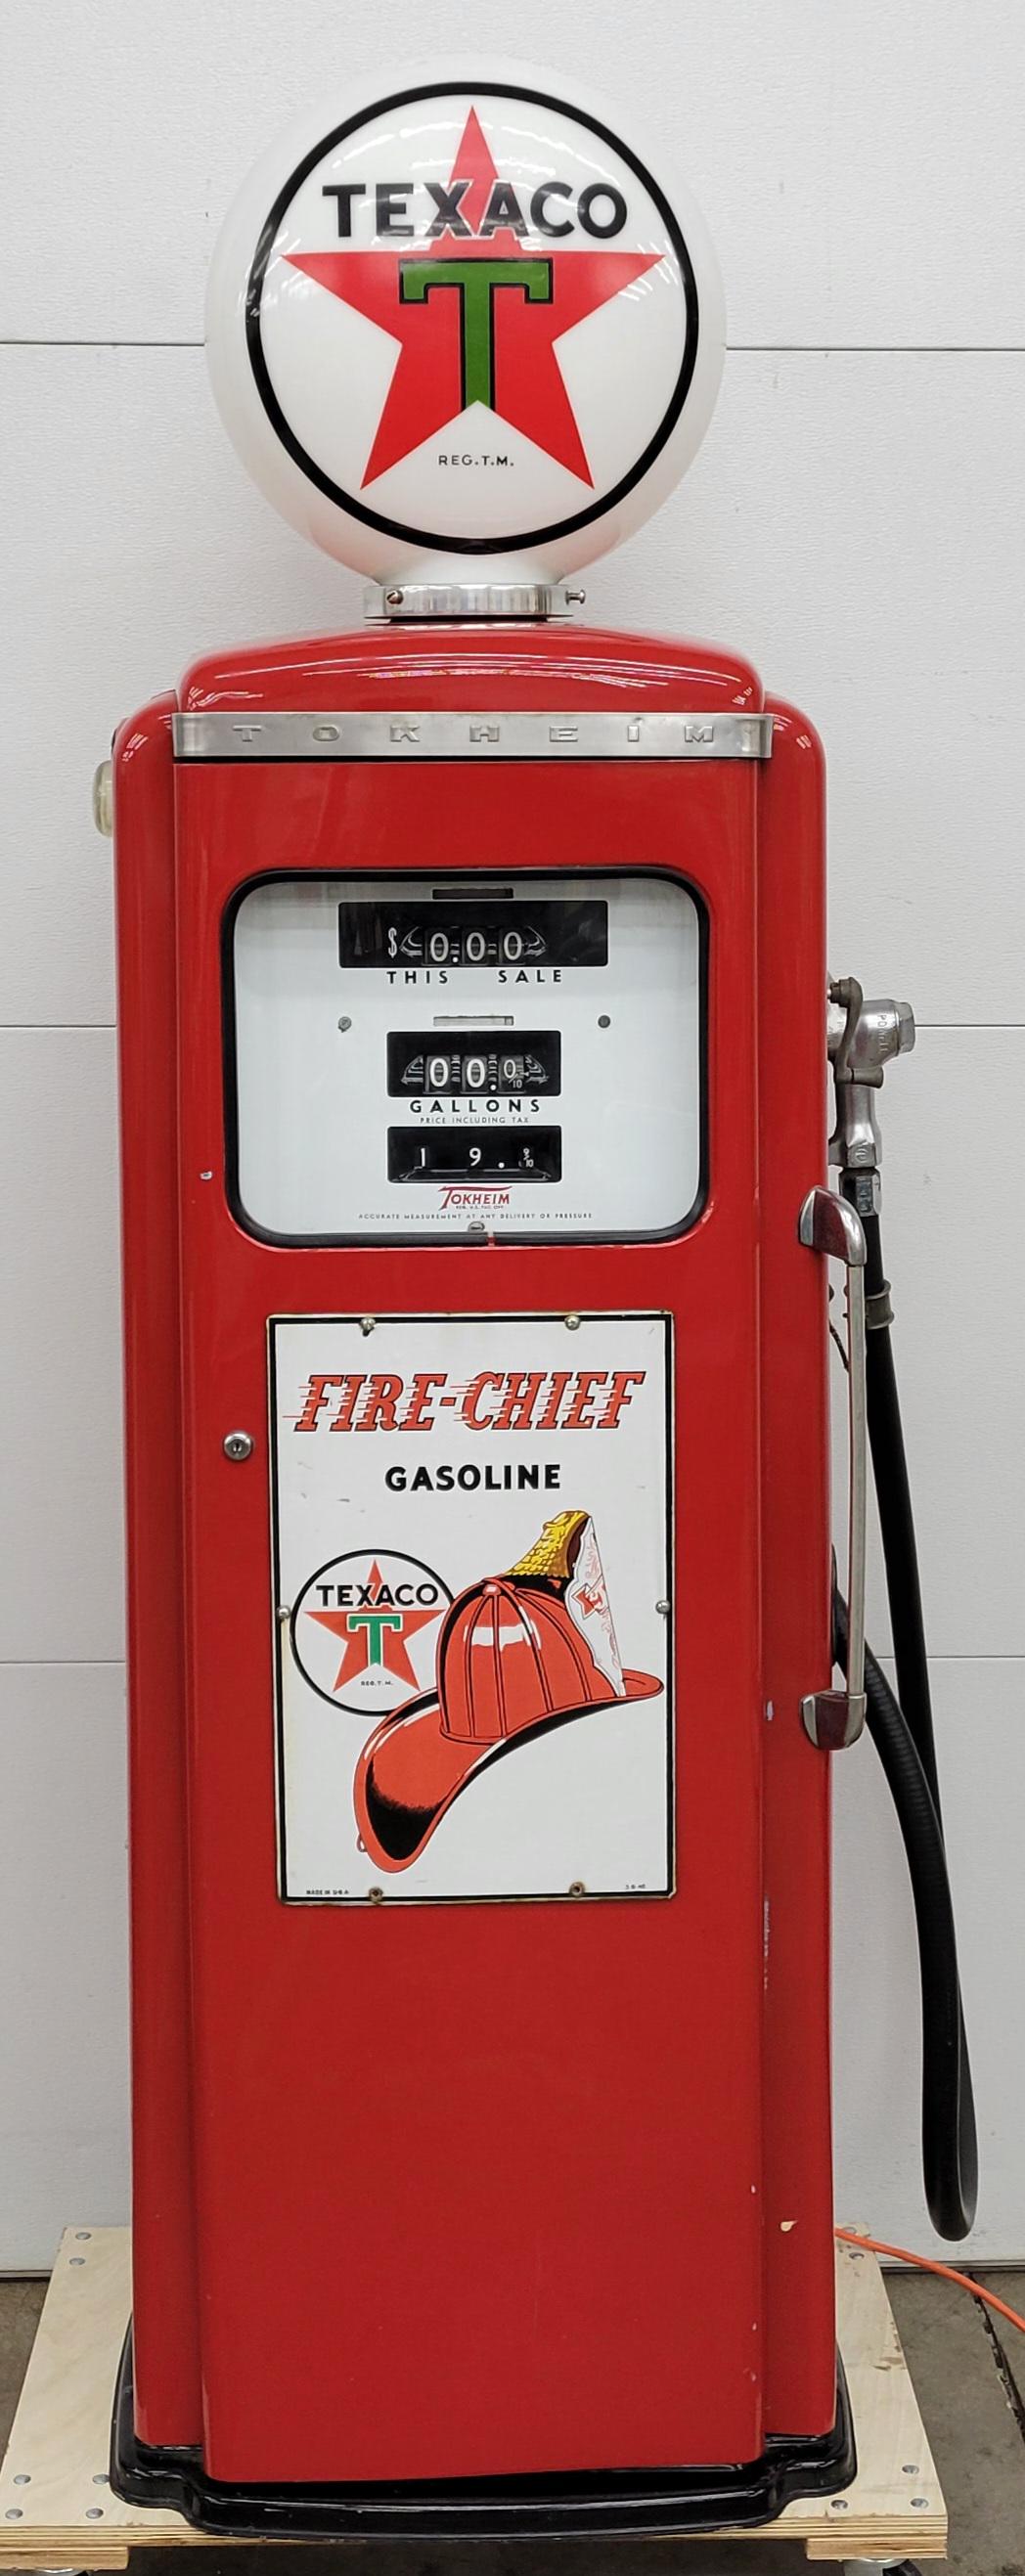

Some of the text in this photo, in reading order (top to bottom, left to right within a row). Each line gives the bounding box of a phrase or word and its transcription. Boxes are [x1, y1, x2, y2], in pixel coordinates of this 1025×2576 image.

[322, 180, 628, 239] TEXACO
[399, 257, 553, 413] T
[232, 724, 715, 743] TOKHEIM
[386, 969, 562, 984] THIS SALE
[410, 1099, 540, 1113] GALLONS
[438, 1185, 512, 1211] TOKHEIM
[291, 1371, 646, 1432] FIRE-CHIEF
[384, 1464, 561, 1492] GASOLINE
[316, 1584, 439, 1607] TEXACO
[347, 1615, 402, 1666] T
